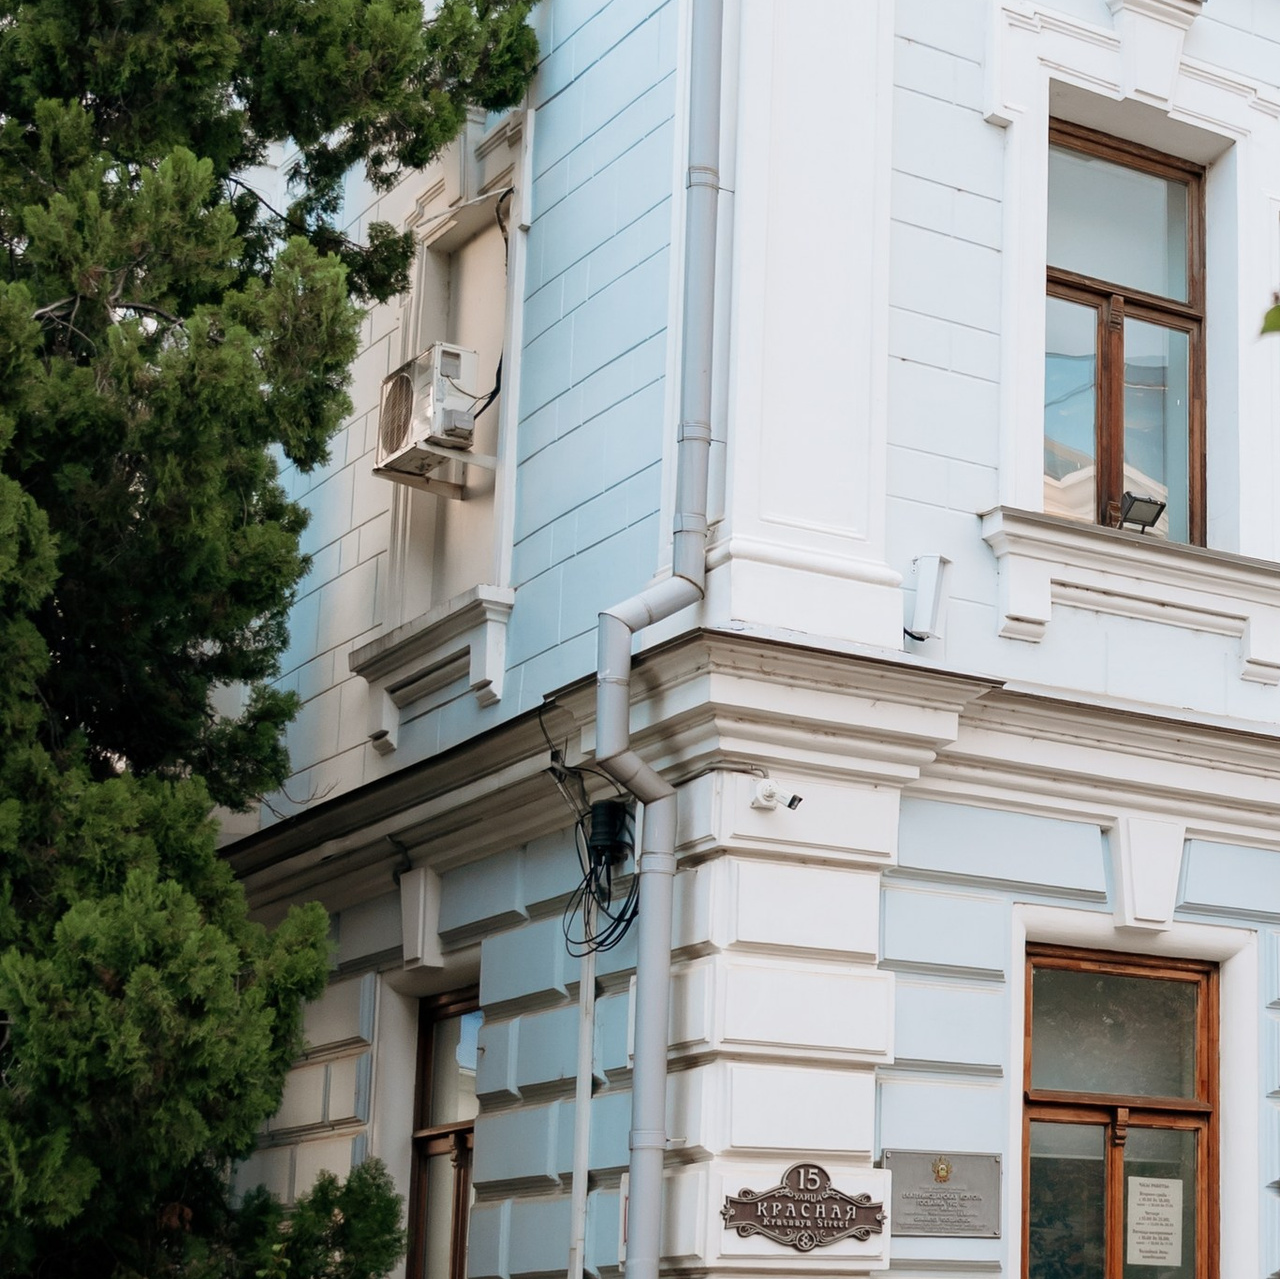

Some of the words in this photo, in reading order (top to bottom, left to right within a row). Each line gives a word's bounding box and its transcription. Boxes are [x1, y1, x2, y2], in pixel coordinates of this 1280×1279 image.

[798, 1168, 820, 1190] 15
[794, 1193, 822, 1202] УЛИЦА
[757, 1202, 856, 1220] КРАСНАЯ
[763, 1218, 812, 1228] Krasnaya
[818, 1219, 849, 1228] Street
